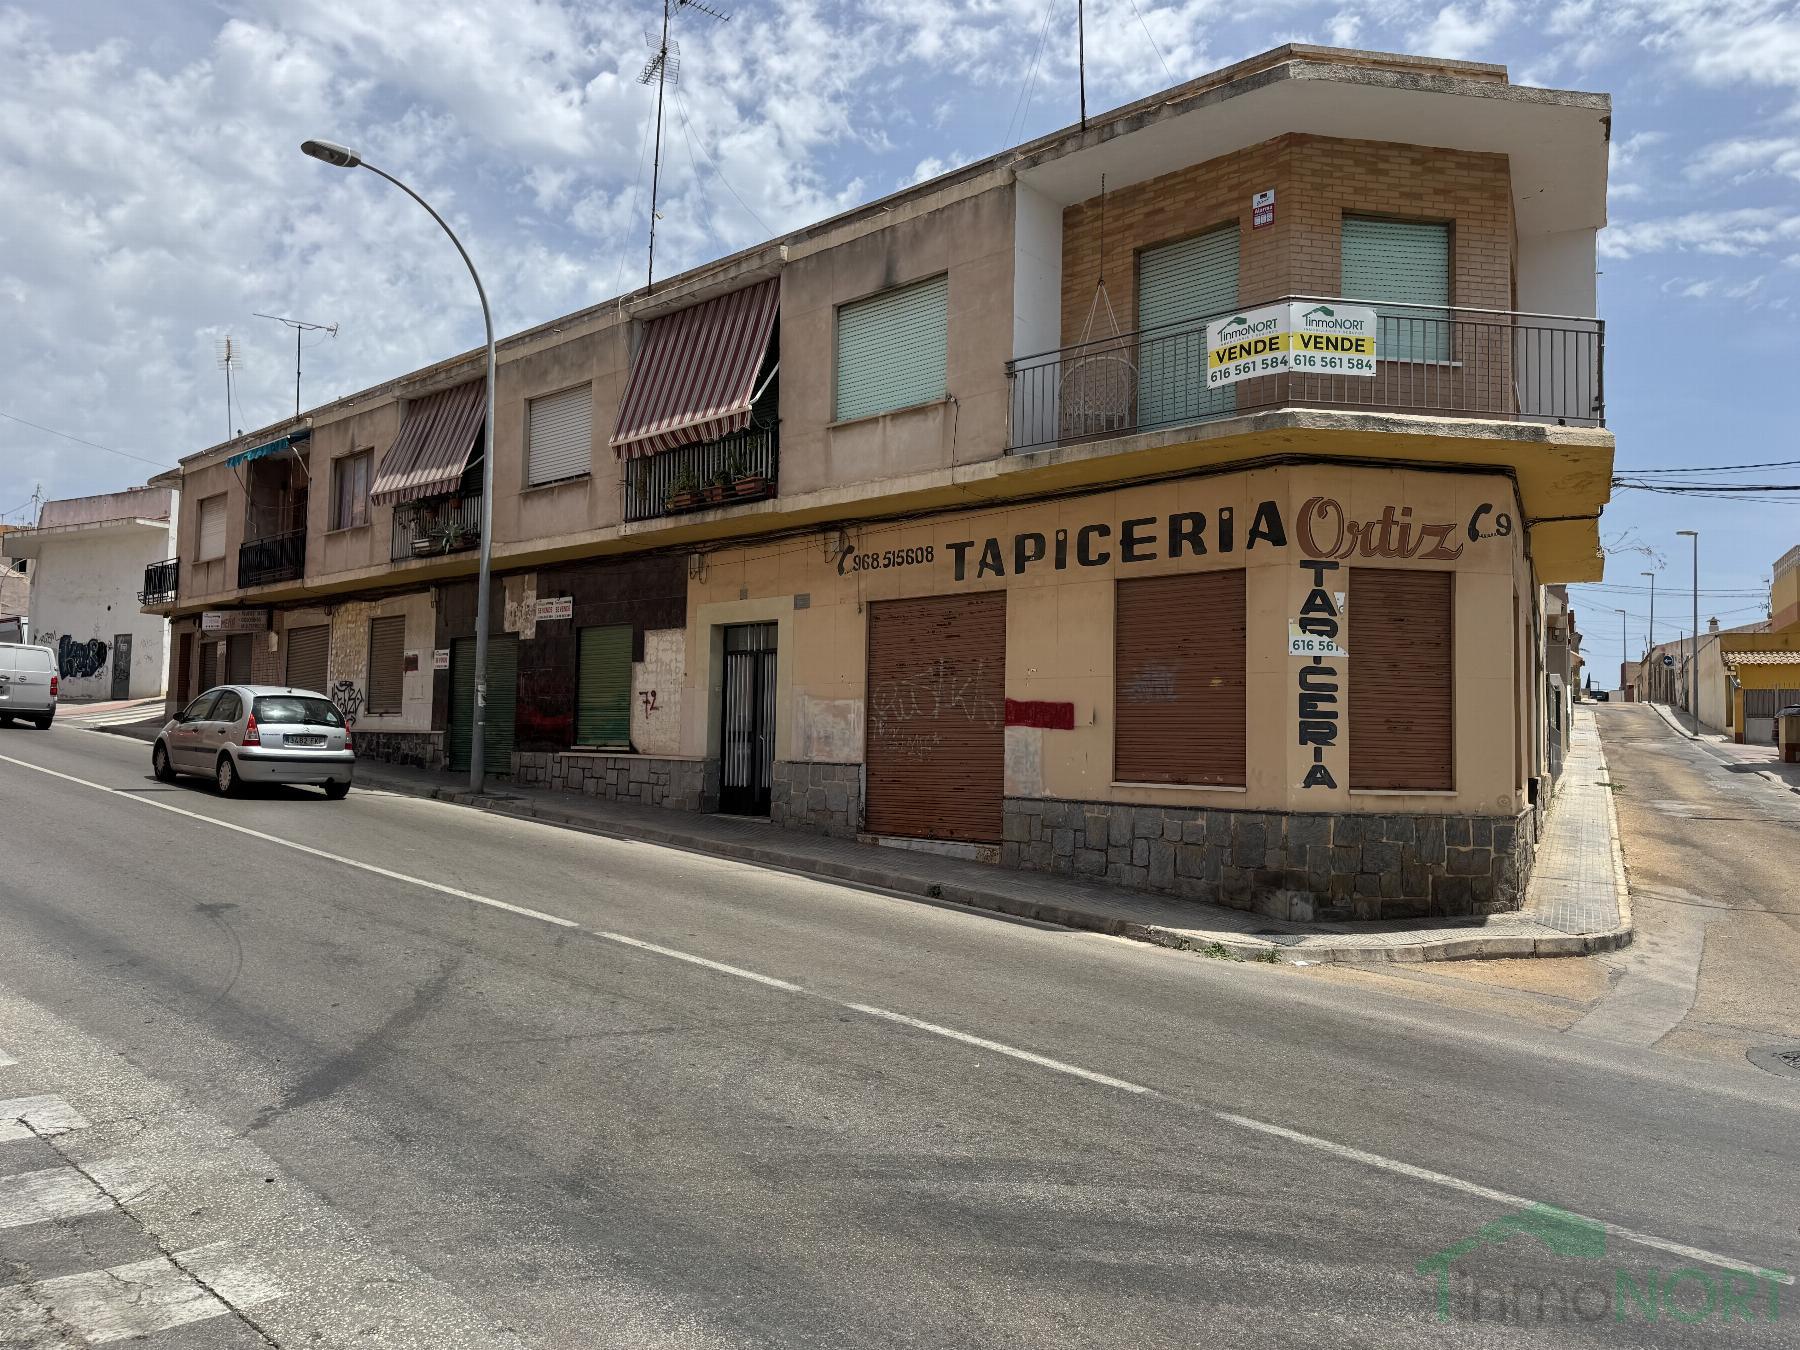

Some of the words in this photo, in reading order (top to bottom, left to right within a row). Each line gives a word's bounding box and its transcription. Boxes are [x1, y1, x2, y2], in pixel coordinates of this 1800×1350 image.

[1216, 336, 1280, 364] VENDE
[1300, 333, 1366, 353] VENDE
[1210, 367, 1231, 383] 616
[1234, 361, 1257, 376] 561
[1261, 354, 1289, 370] 584
[1293, 354, 1316, 367] 616
[1320, 356, 1343, 369] 561
[1347, 357, 1373, 371] 584
[853, 545, 935, 572] 968.515608
[946, 500, 1288, 581] TAPICERIA
[1296, 497, 1464, 561] Ortiz
[1292, 639, 1314, 651] 616
